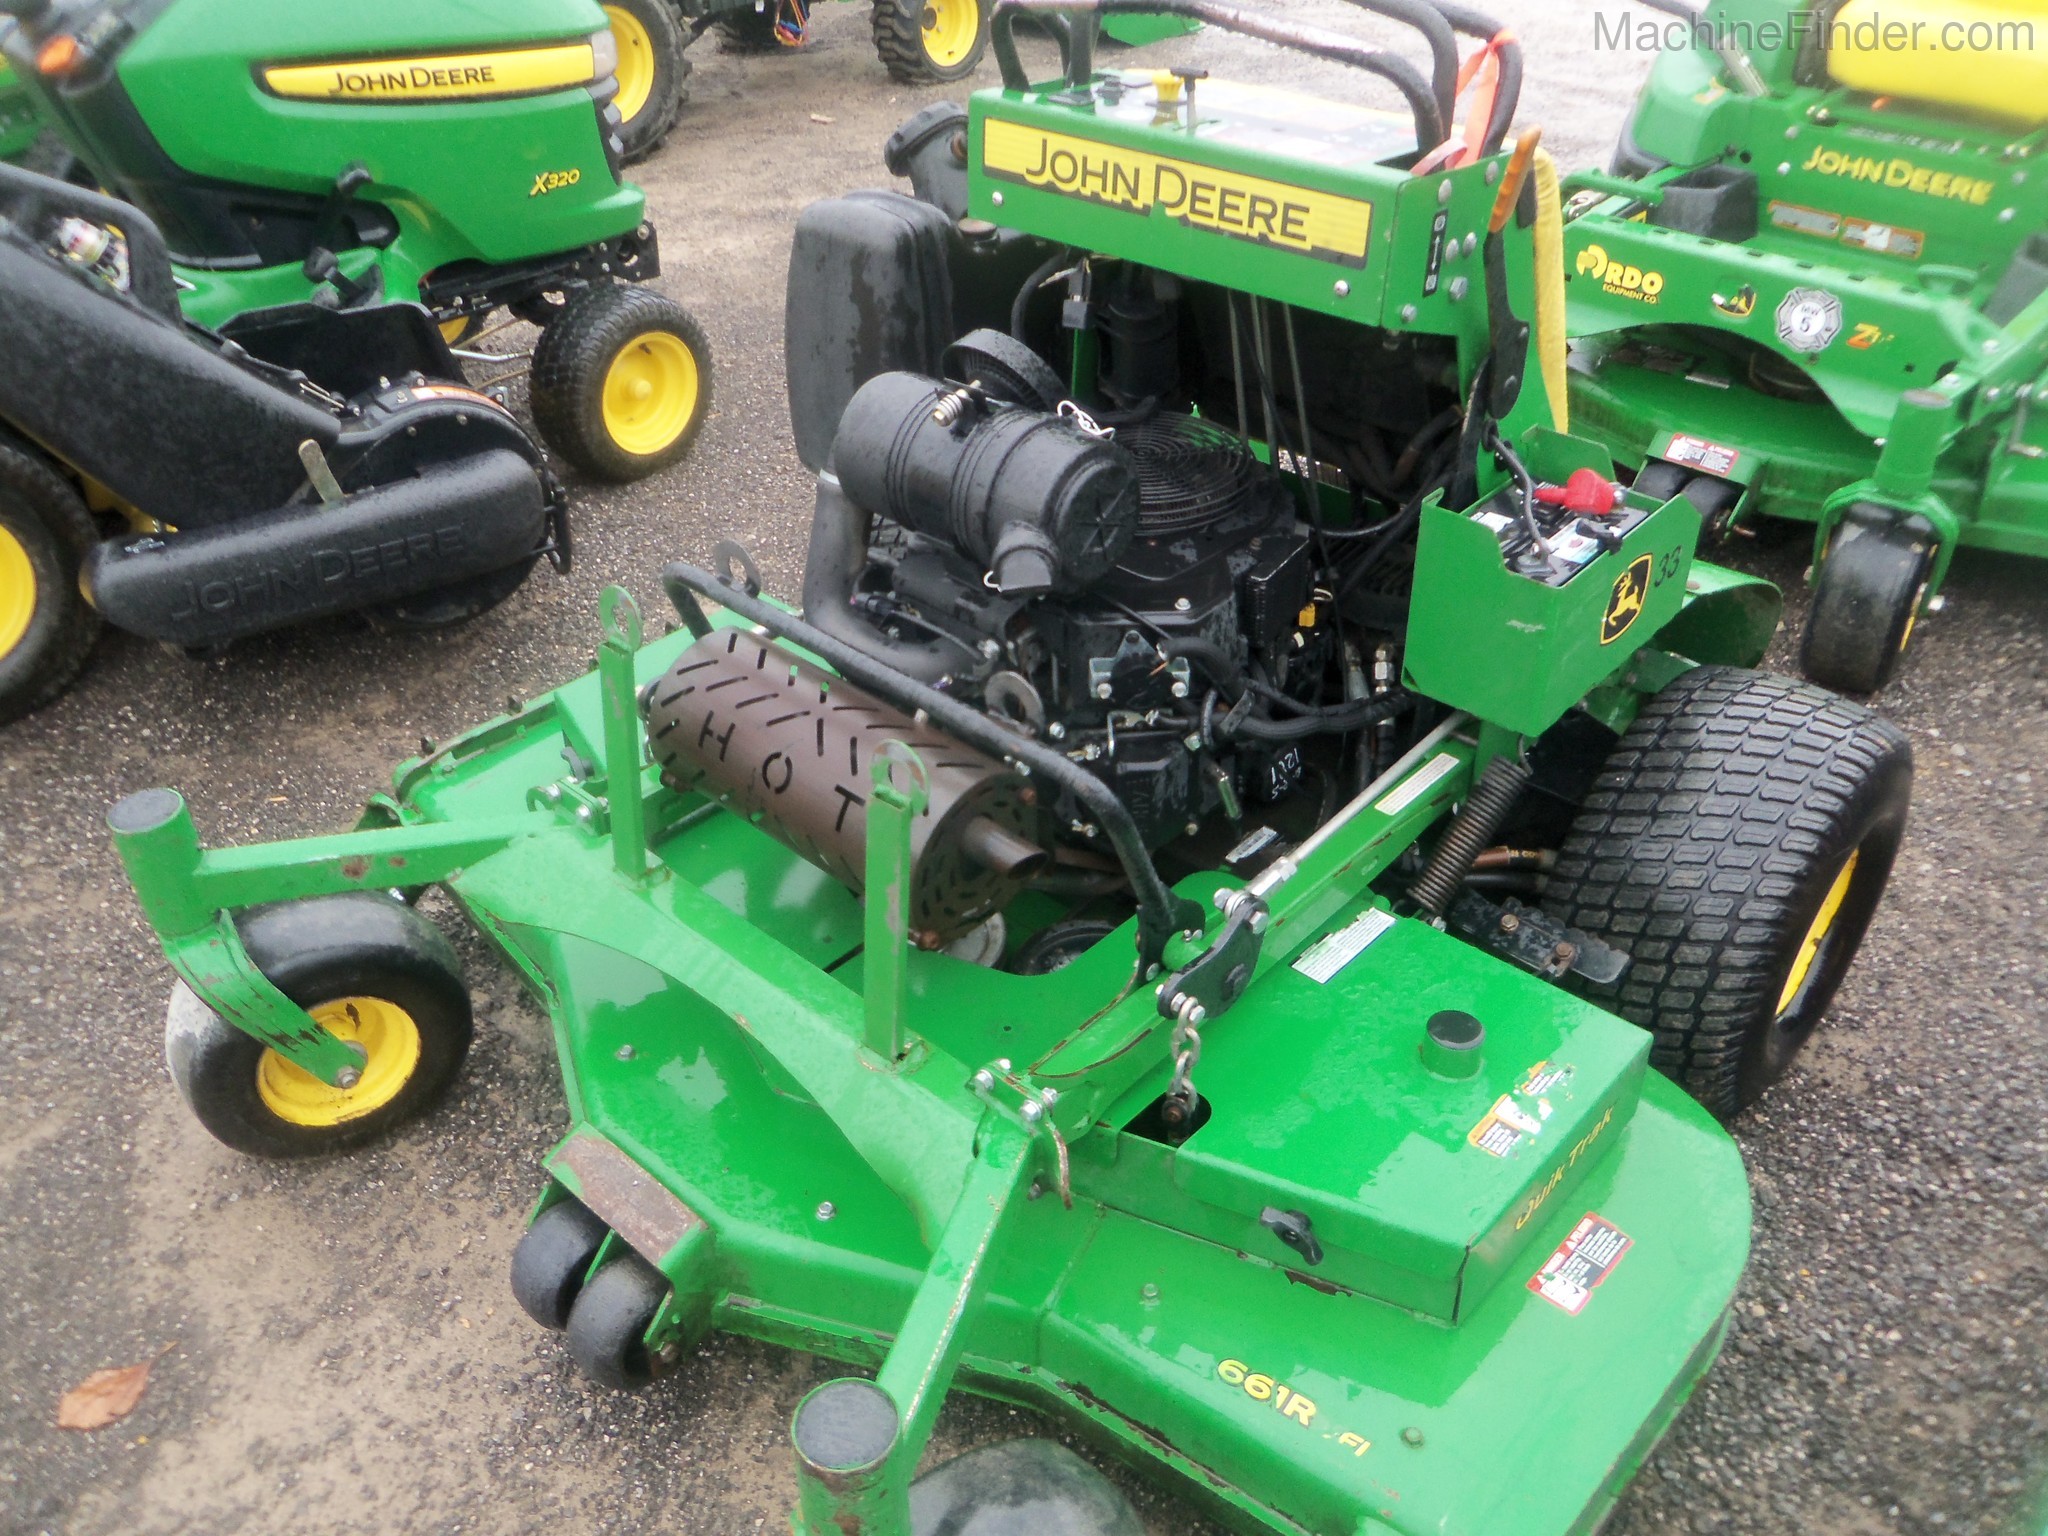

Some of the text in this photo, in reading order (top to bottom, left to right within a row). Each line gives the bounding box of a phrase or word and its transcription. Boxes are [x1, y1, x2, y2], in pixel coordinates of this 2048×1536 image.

[328, 65, 495, 94] JOHN DEERE
[529, 168, 580, 197] X320
[1025, 138, 1310, 240] JOHN DEERE
[1802, 145, 1995, 206] JOHN DEERE
[172, 525, 464, 622] JOHN DEERE
[1653, 545, 1682, 588] 33
[698, 709, 865, 833] HOT
[1217, 1358, 1317, 1428] 661R
